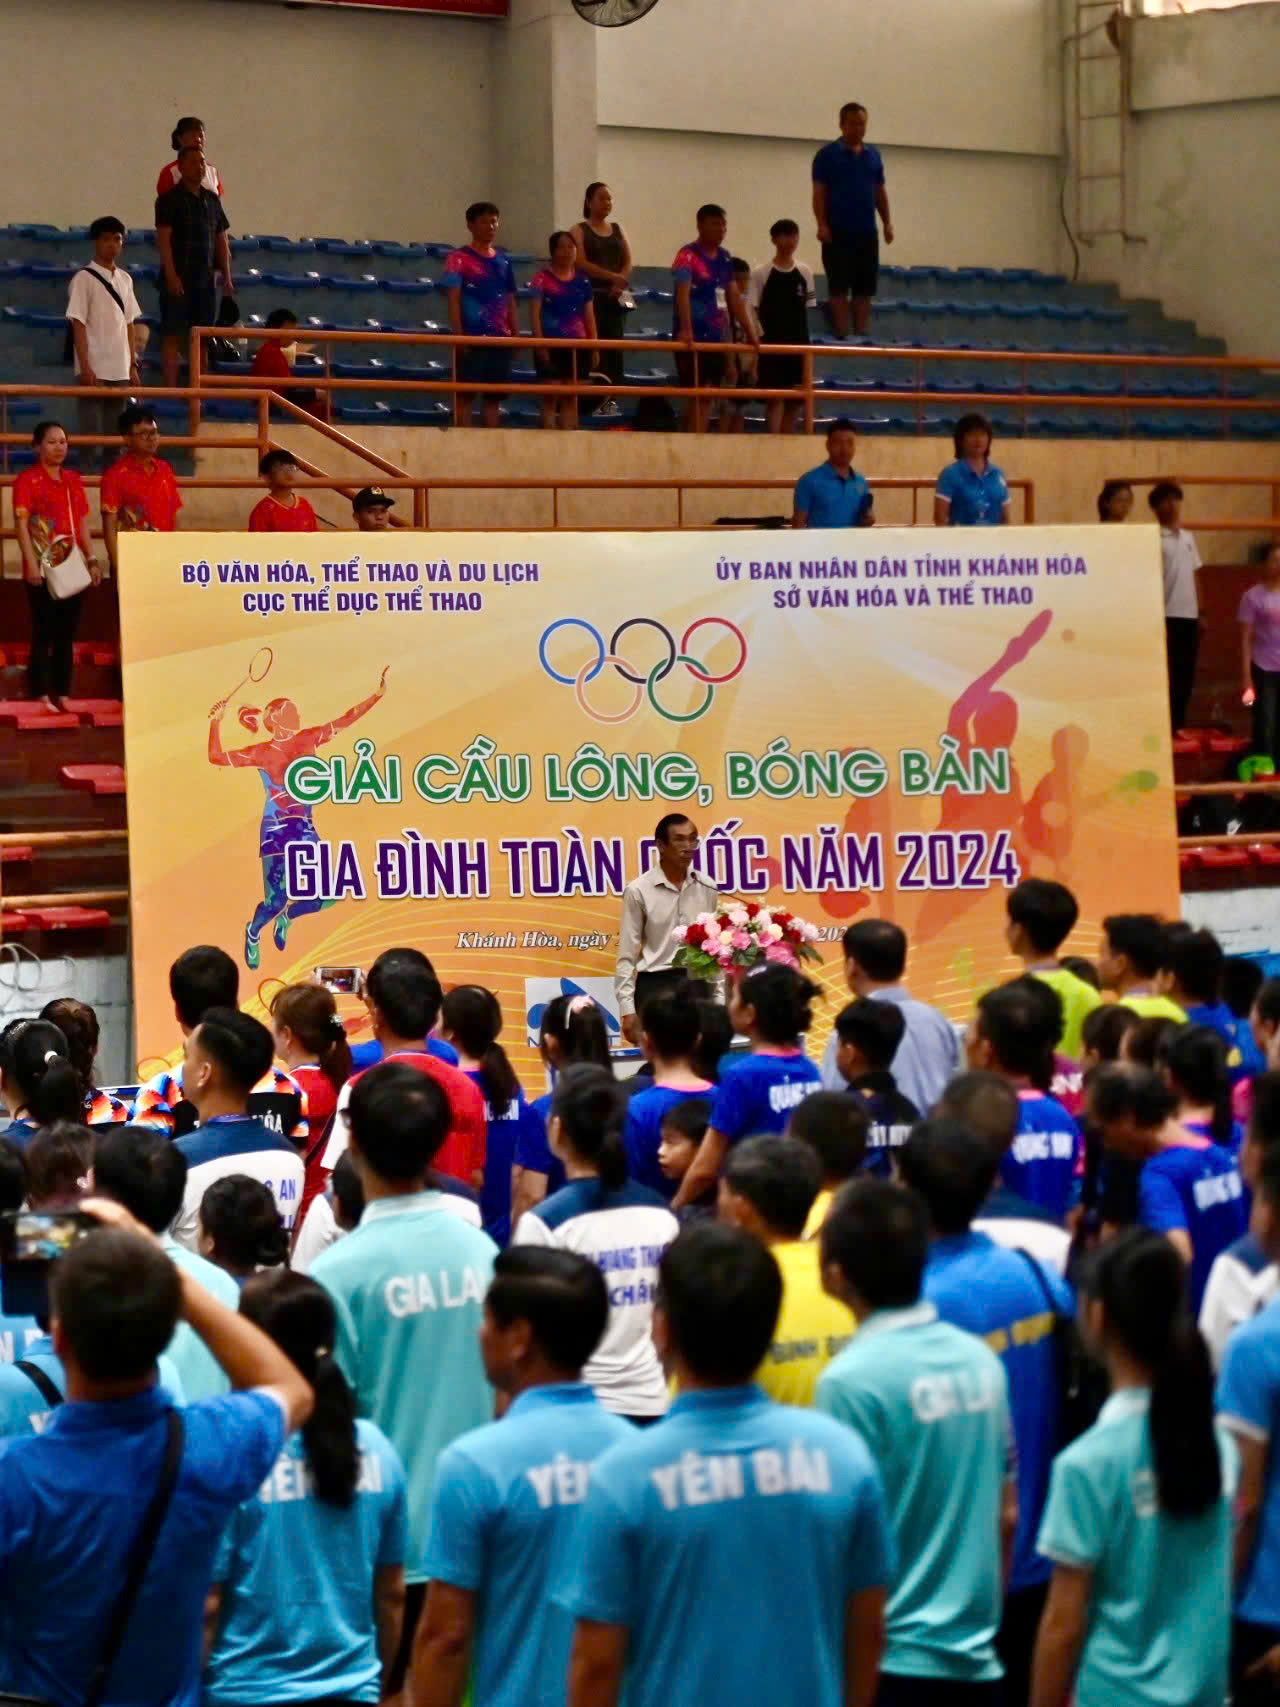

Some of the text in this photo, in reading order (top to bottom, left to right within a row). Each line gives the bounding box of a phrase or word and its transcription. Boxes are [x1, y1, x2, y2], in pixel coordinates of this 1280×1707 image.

[182, 555, 540, 588] BỘ VĂN HÓA, THỂ THAO VÀ DU LỊCH
[716, 556, 742, 581] ỦY
[750, 561, 793, 580] BAN
[799, 557, 857, 580] NHÂN
[864, 556, 908, 579] DÂN
[914, 553, 962, 578] TỈNH
[969, 555, 1039, 577] KHÁNH
[242, 585, 482, 617] CỤC THỂ DỤC THỂ THAO
[773, 580, 1034, 609] SỞ VĂN HÓA VÀ THỂ THAO
[286, 735, 1010, 807] GIẢI CẦU LÔNG, BÓNG BÀN
[286, 841, 365, 899] GIA
[376, 828, 489, 898] ĐÌNH
[500, 827, 623, 896] TOÀN
[781, 825, 883, 892] NĂM
[895, 831, 1018, 891] 2024
[456, 931, 517, 949] Khánh
[521, 930, 563, 950] Hòa,
[568, 930, 611, 951] ngày
[384, 1266, 486, 1319] GIA LA
[652, 1439, 832, 1510] YÊN BÁI
